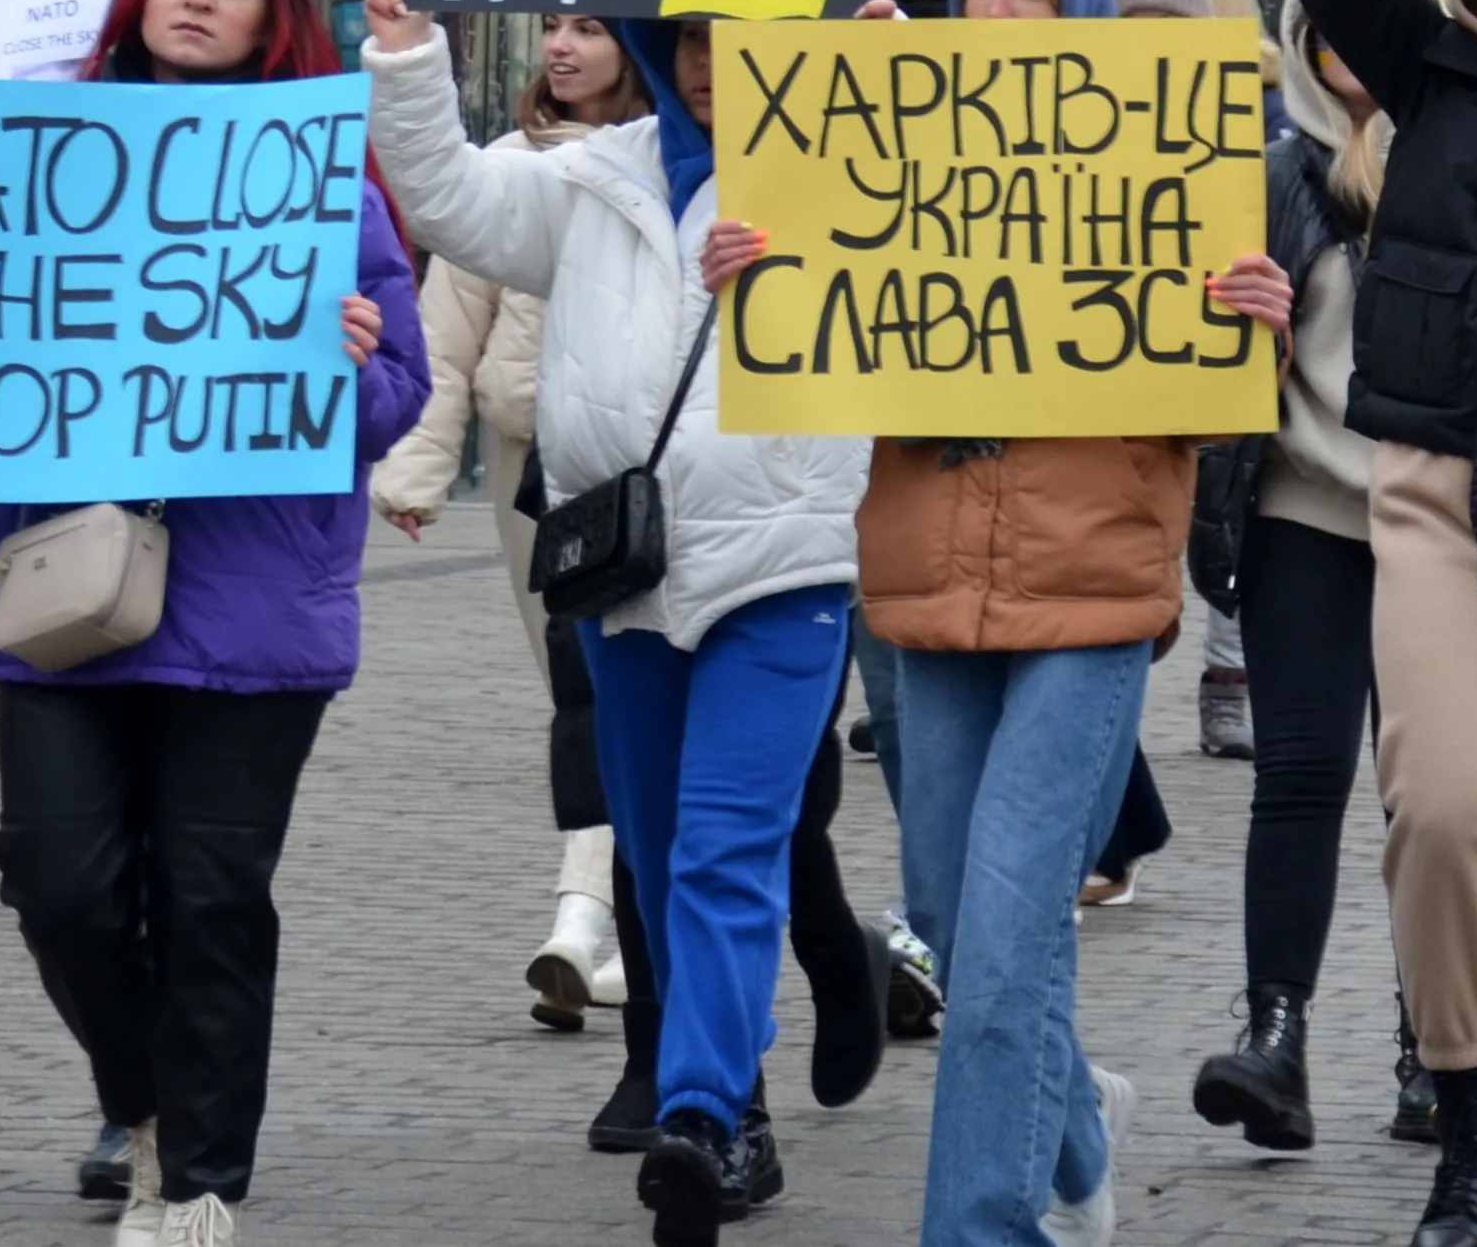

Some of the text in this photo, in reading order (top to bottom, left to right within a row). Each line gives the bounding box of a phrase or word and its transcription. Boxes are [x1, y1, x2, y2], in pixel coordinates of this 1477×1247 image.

[2, 35, 43, 55] CLOSE
[47, 32, 73, 47] THE
[27, 0, 79, 23] NATO
[739, 48, 1263, 174] ХАРКІВ-ЦЕ
[147, 112, 366, 234] CLOSE
[830, 158, 1203, 267] УКРАЇНА
[139, 243, 319, 344] SKY
[732, 256, 1034, 375] СЛАВА
[122, 364, 349, 458] PUTIN
